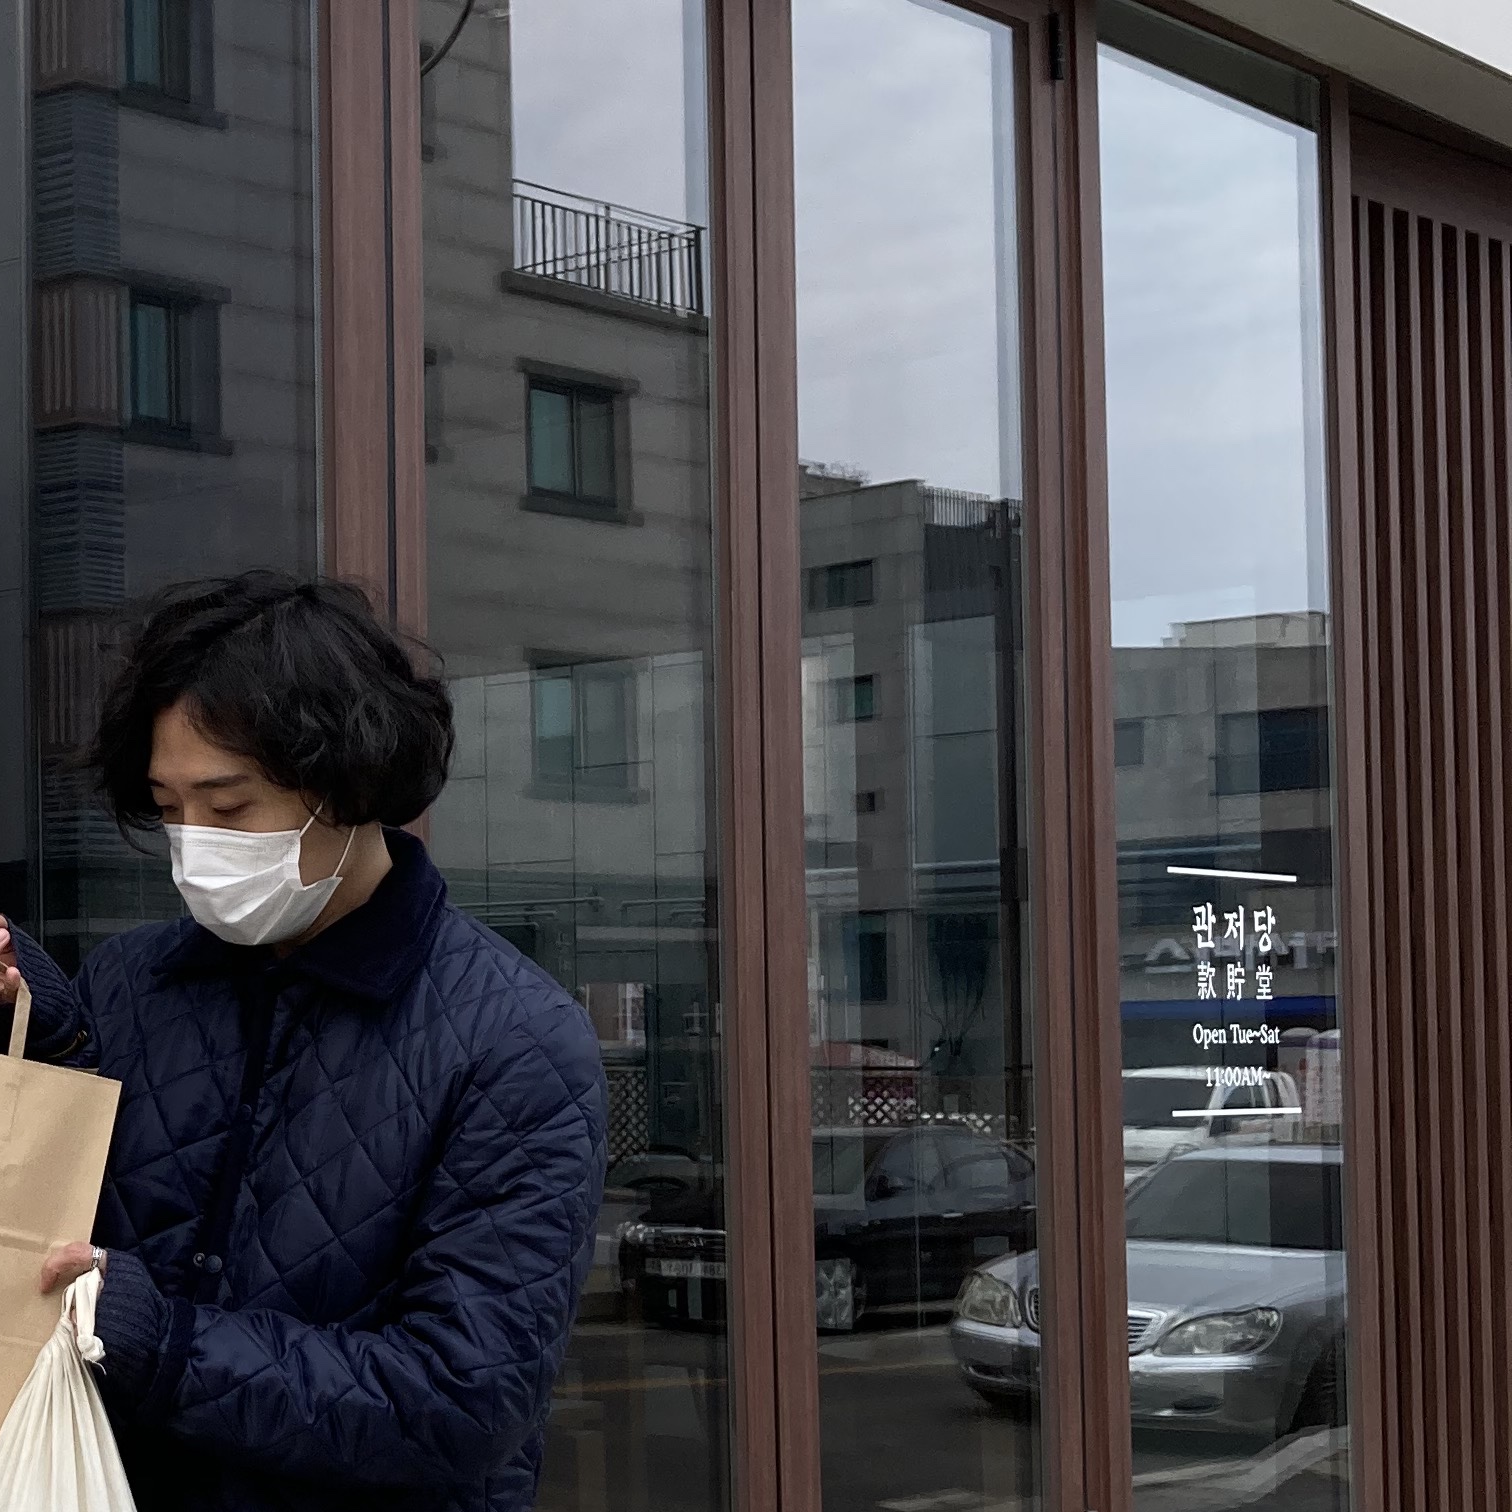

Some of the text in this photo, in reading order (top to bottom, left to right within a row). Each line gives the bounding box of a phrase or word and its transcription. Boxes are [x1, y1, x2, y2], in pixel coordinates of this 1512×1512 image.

[1192, 902, 1276, 953] 관저당
[1193, 1023, 1280, 1050] Open Tue~Sat
